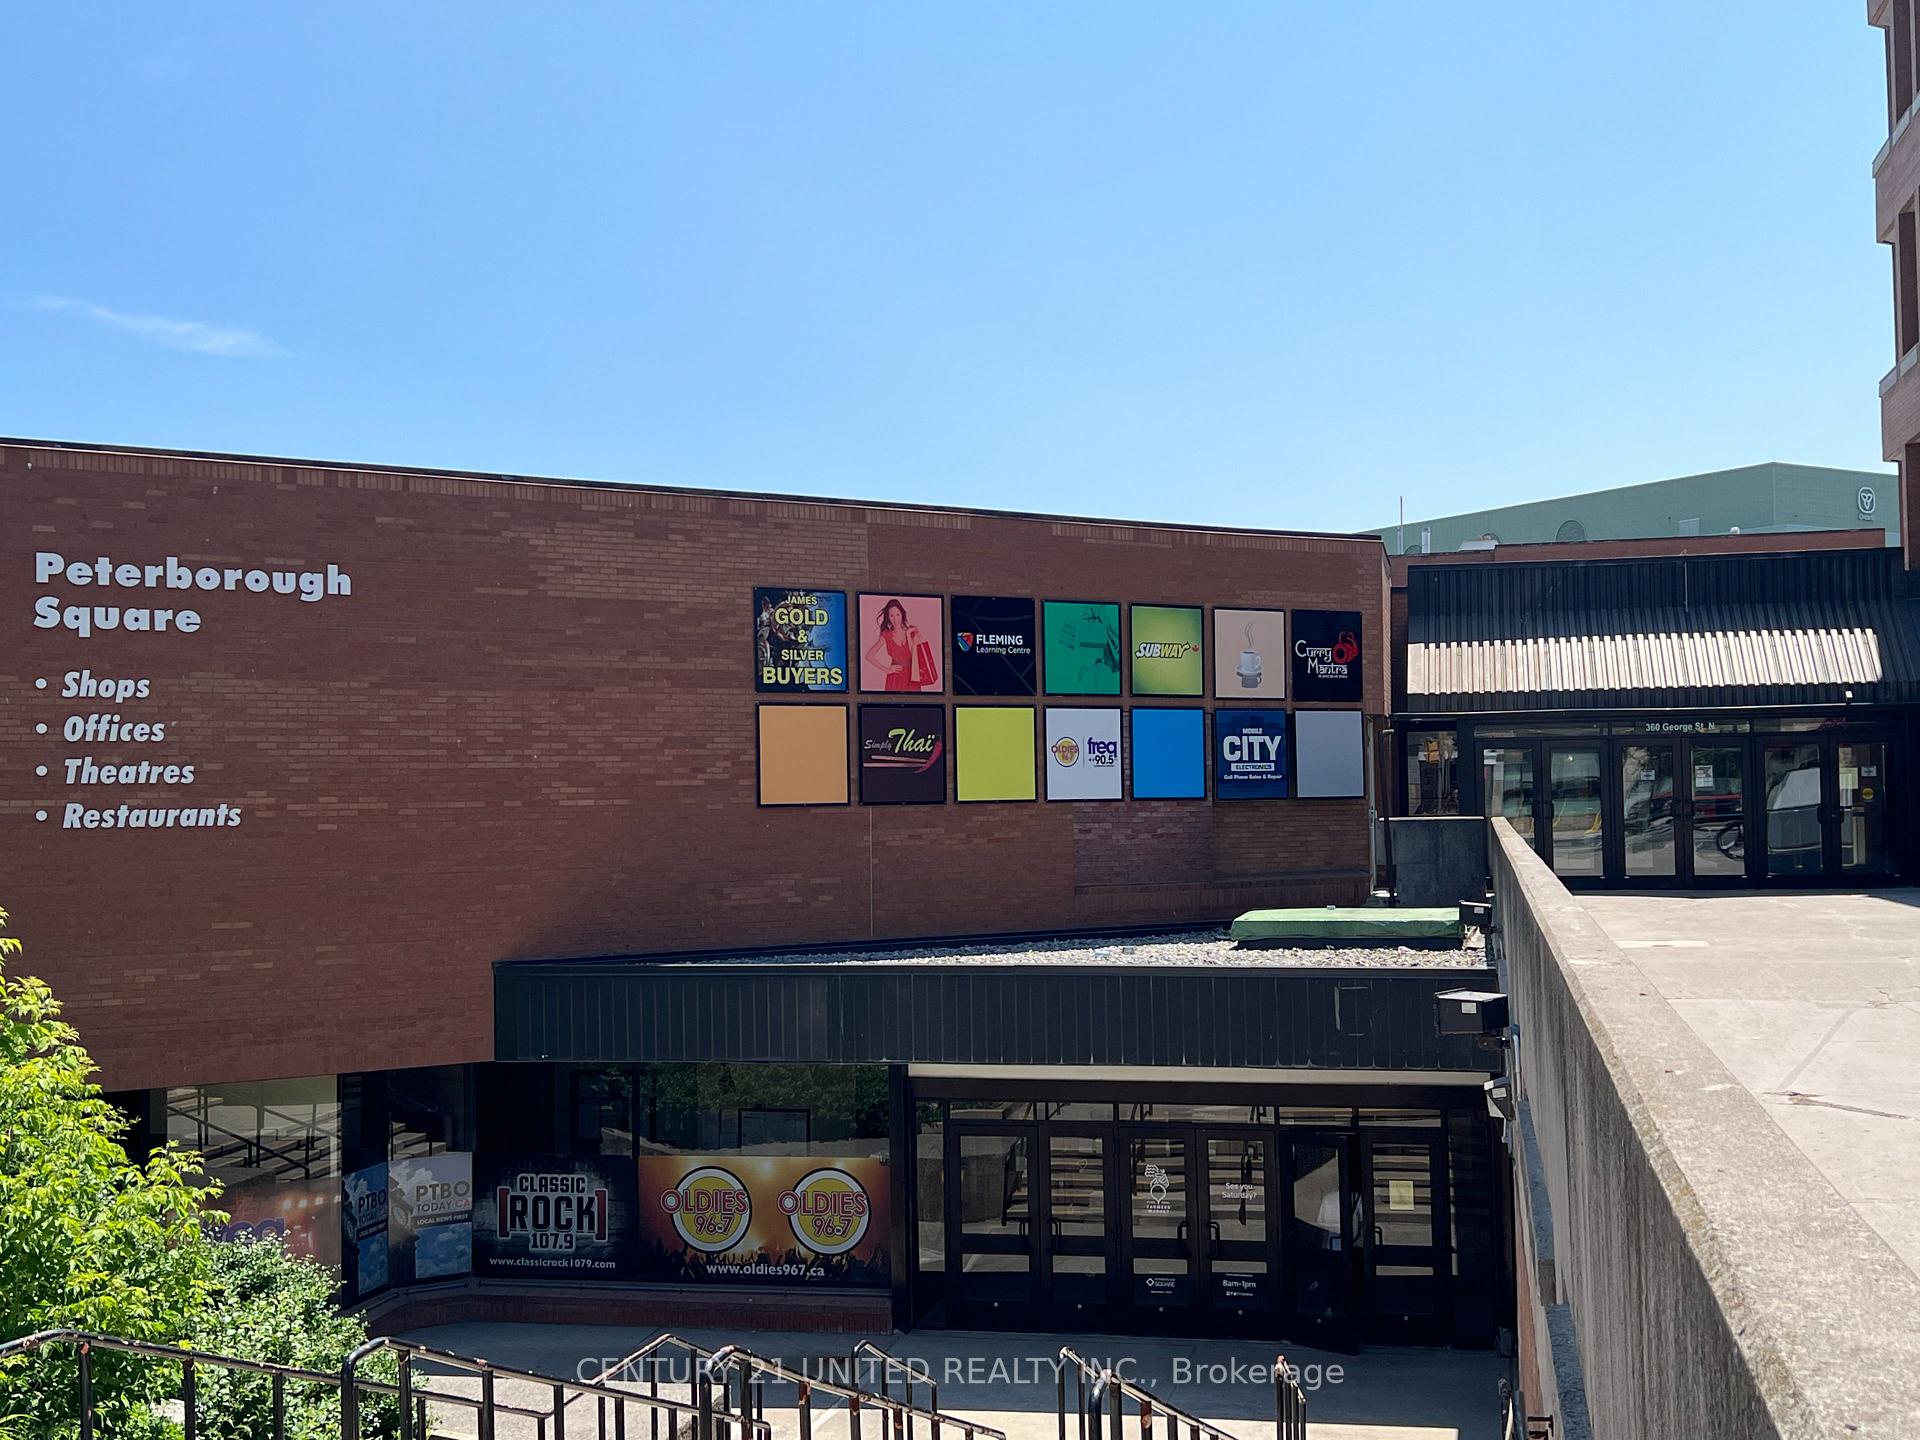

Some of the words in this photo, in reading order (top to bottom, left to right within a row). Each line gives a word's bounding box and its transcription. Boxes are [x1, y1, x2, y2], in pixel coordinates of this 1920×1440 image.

[35, 551, 352, 602] Peterborough
[785, 595, 817, 605] JAMES
[33, 596, 201, 638] Square
[774, 607, 829, 626] GOLD
[797, 629, 808, 643] &
[976, 634, 1023, 645] FLEMING
[781, 649, 824, 661] SILVER
[976, 646, 1006, 655] Learning
[1007, 646, 1031, 655] Centre
[1135, 642, 1190, 659] SUBWAY
[1295, 639, 1332, 663] Curry
[1307, 657, 1348, 675] Mantra
[762, 667, 843, 685] BUYERS
[62, 669, 150, 703] Shops
[63, 714, 165, 742] Offices
[1645, 723, 1660, 732] 360
[1662, 722, 1693, 732] George
[1708, 721, 1715, 730] N
[864, 739, 893, 751] Simply
[1087, 736, 1118, 758] freq
[1223, 735, 1282, 762] CITY
[1095, 754, 1114, 765] 90.5
[64, 756, 195, 784] Theatres
[63, 803, 242, 829] Restaurants
[415, 1180, 471, 1202] PTBO
[519, 1175, 586, 1194] CLASSIC
[358, 1189, 387, 1214] PTBO
[660, 1188, 750, 1215] OLDIES
[777, 1190, 869, 1217] OLDIES
[416, 1218, 435, 1226] LOCAL
[509, 1194, 597, 1234] ROCK
[694, 1214, 734, 1235] 96.7
[812, 1216, 853, 1238] 96.7
[529, 1232, 575, 1250] 107.9
[489, 1257, 616, 1269] www.classicrock1079.com
[706, 1263, 825, 1277] www.oldies967.ca
